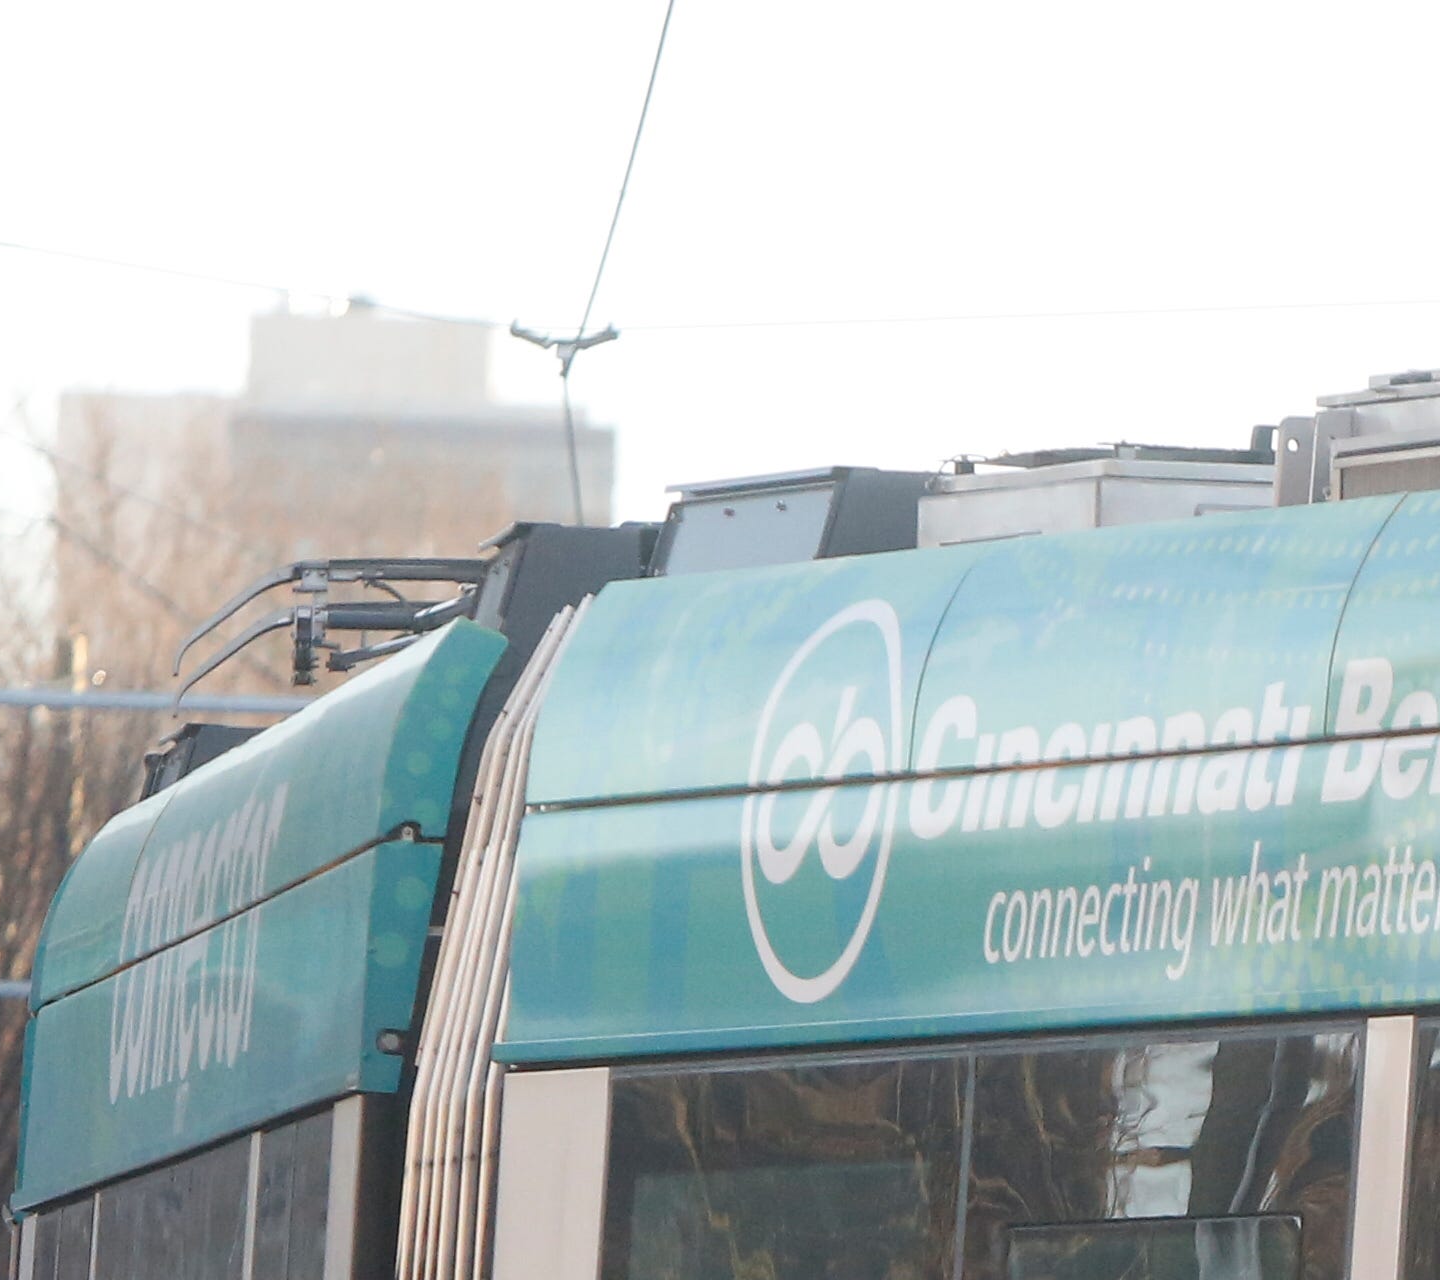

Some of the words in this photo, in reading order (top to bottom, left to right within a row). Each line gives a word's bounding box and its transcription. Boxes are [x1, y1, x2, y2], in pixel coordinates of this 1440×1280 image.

[909, 680, 1311, 840] Cincinnati
[110, 781, 291, 1105] connector
[983, 855, 1199, 981] connecting
[1210, 840, 1308, 947] what
